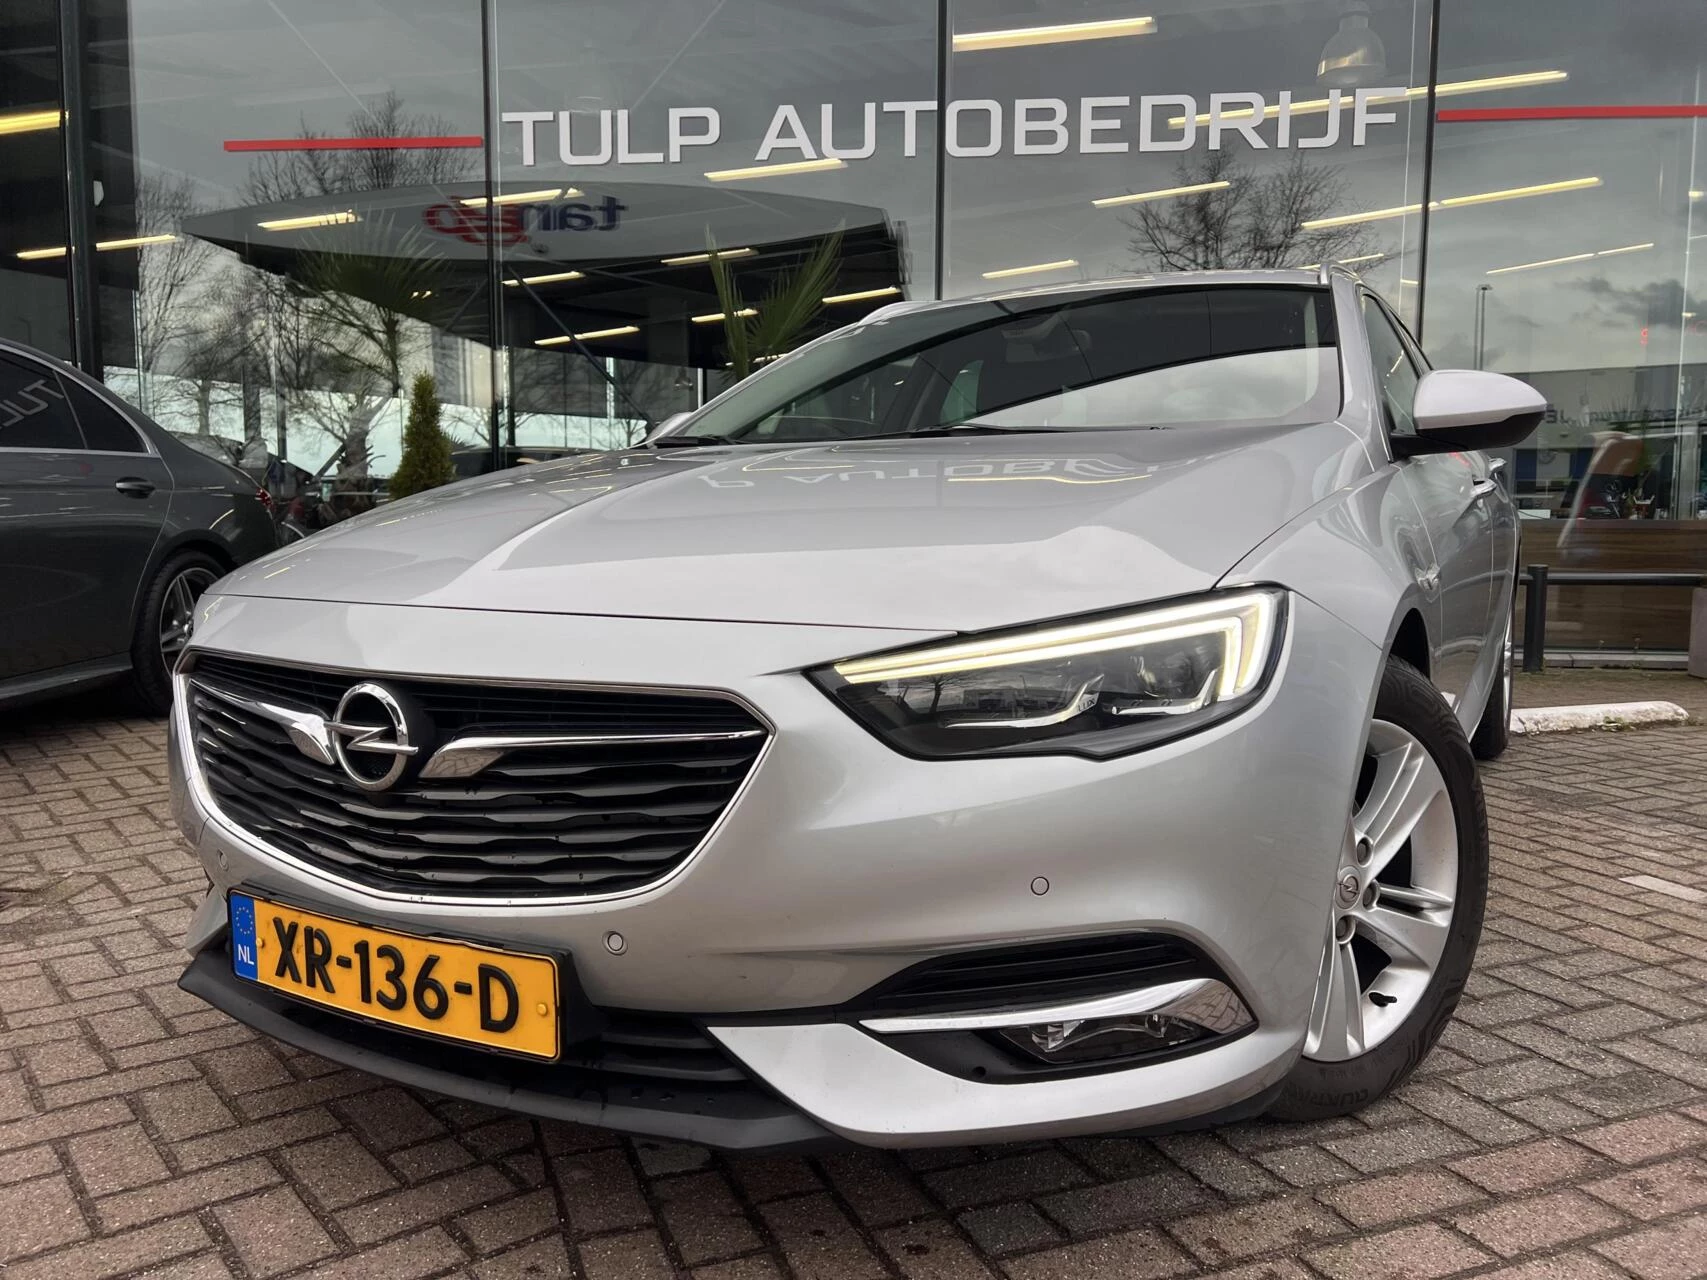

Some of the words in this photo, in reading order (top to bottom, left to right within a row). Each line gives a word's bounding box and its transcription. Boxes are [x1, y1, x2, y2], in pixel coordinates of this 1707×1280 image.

[502, 107, 720, 166] TULP
[754, 86, 1407, 160] AUTOBEDRIJF
[238, 943, 255, 965] NL
[272, 916, 520, 1034] XR-136-D
